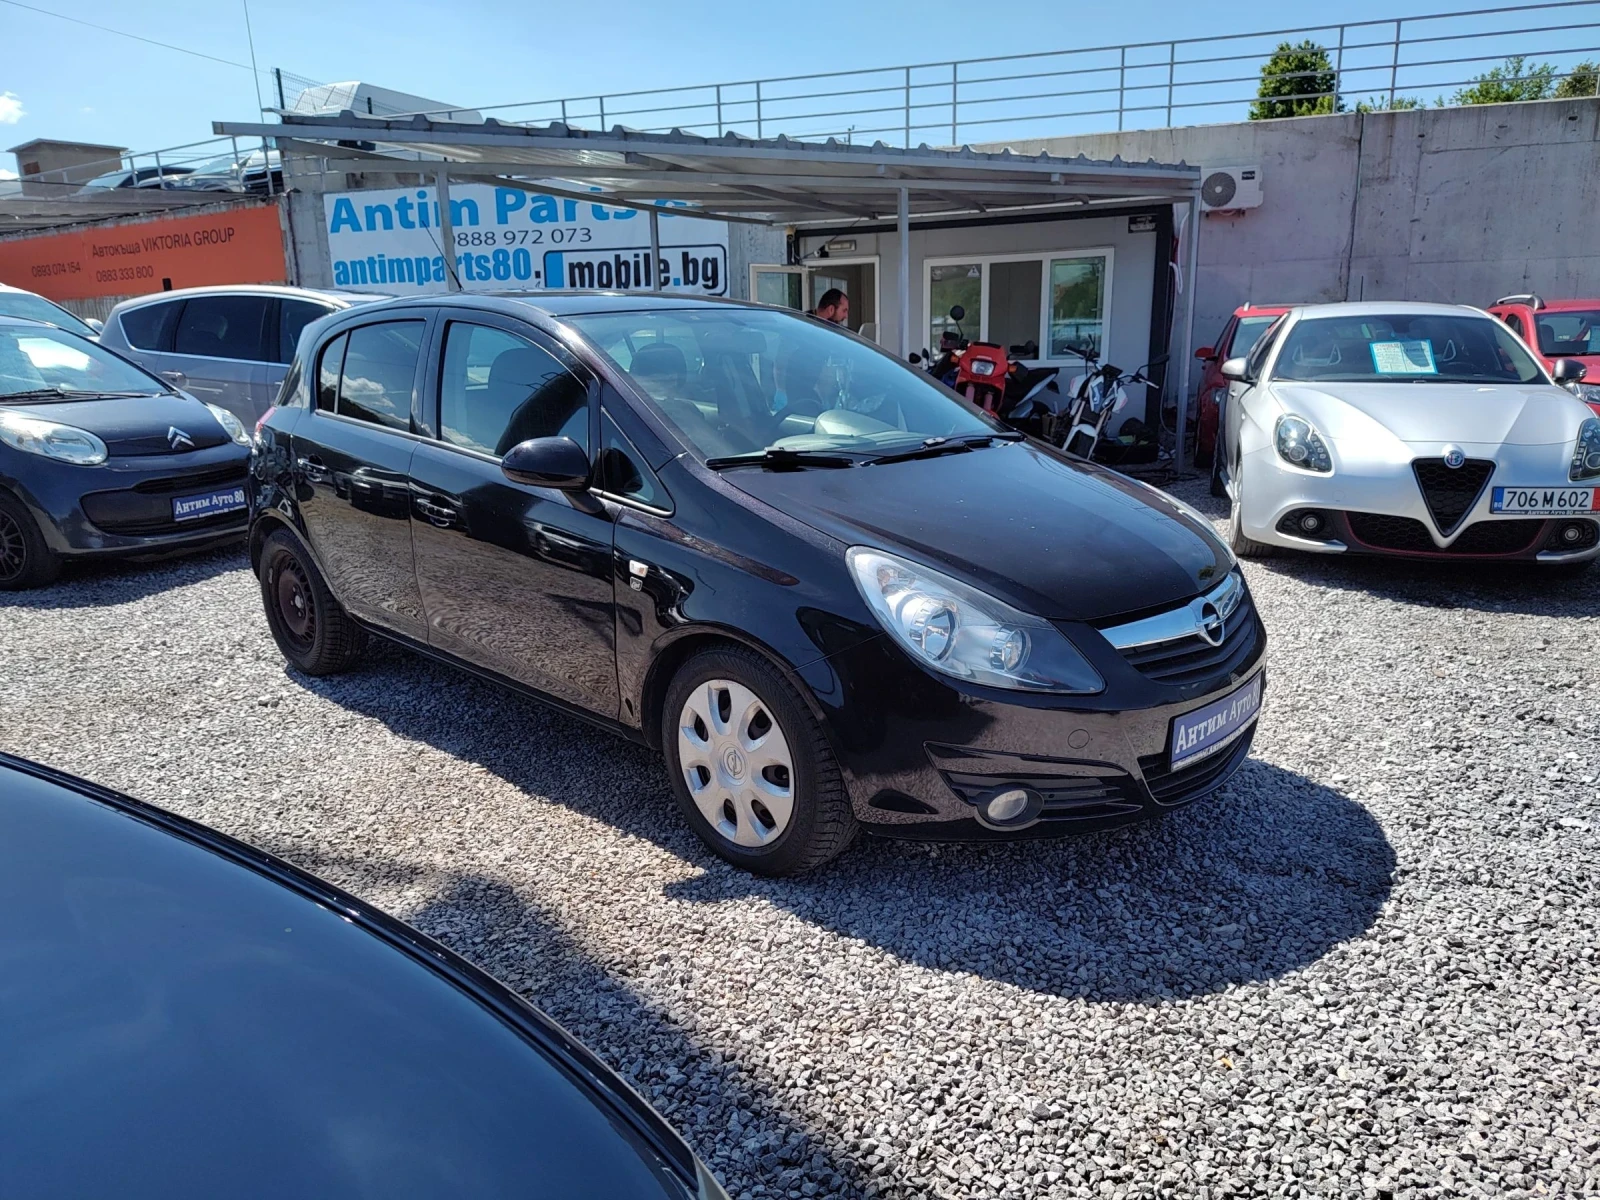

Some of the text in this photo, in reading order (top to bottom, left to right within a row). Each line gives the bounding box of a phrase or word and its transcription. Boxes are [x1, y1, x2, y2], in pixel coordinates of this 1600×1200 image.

[330, 189, 480, 234] Antim
[92, 227, 235, 258] Автокъща VIKTORIA GROUP
[452, 227, 593, 246] 888 972 073
[52, 262, 67, 276] 074
[67, 261, 81, 274] 154
[96, 265, 154, 283] 0883 333 800
[176, 498, 210, 515] Антим
[211, 495, 234, 506] Ауто
[233, 490, 245, 502] 80
[1506, 491, 1539, 508] 706
[1557, 491, 1590, 508] 602
[1175, 709, 1228, 755] Антим
